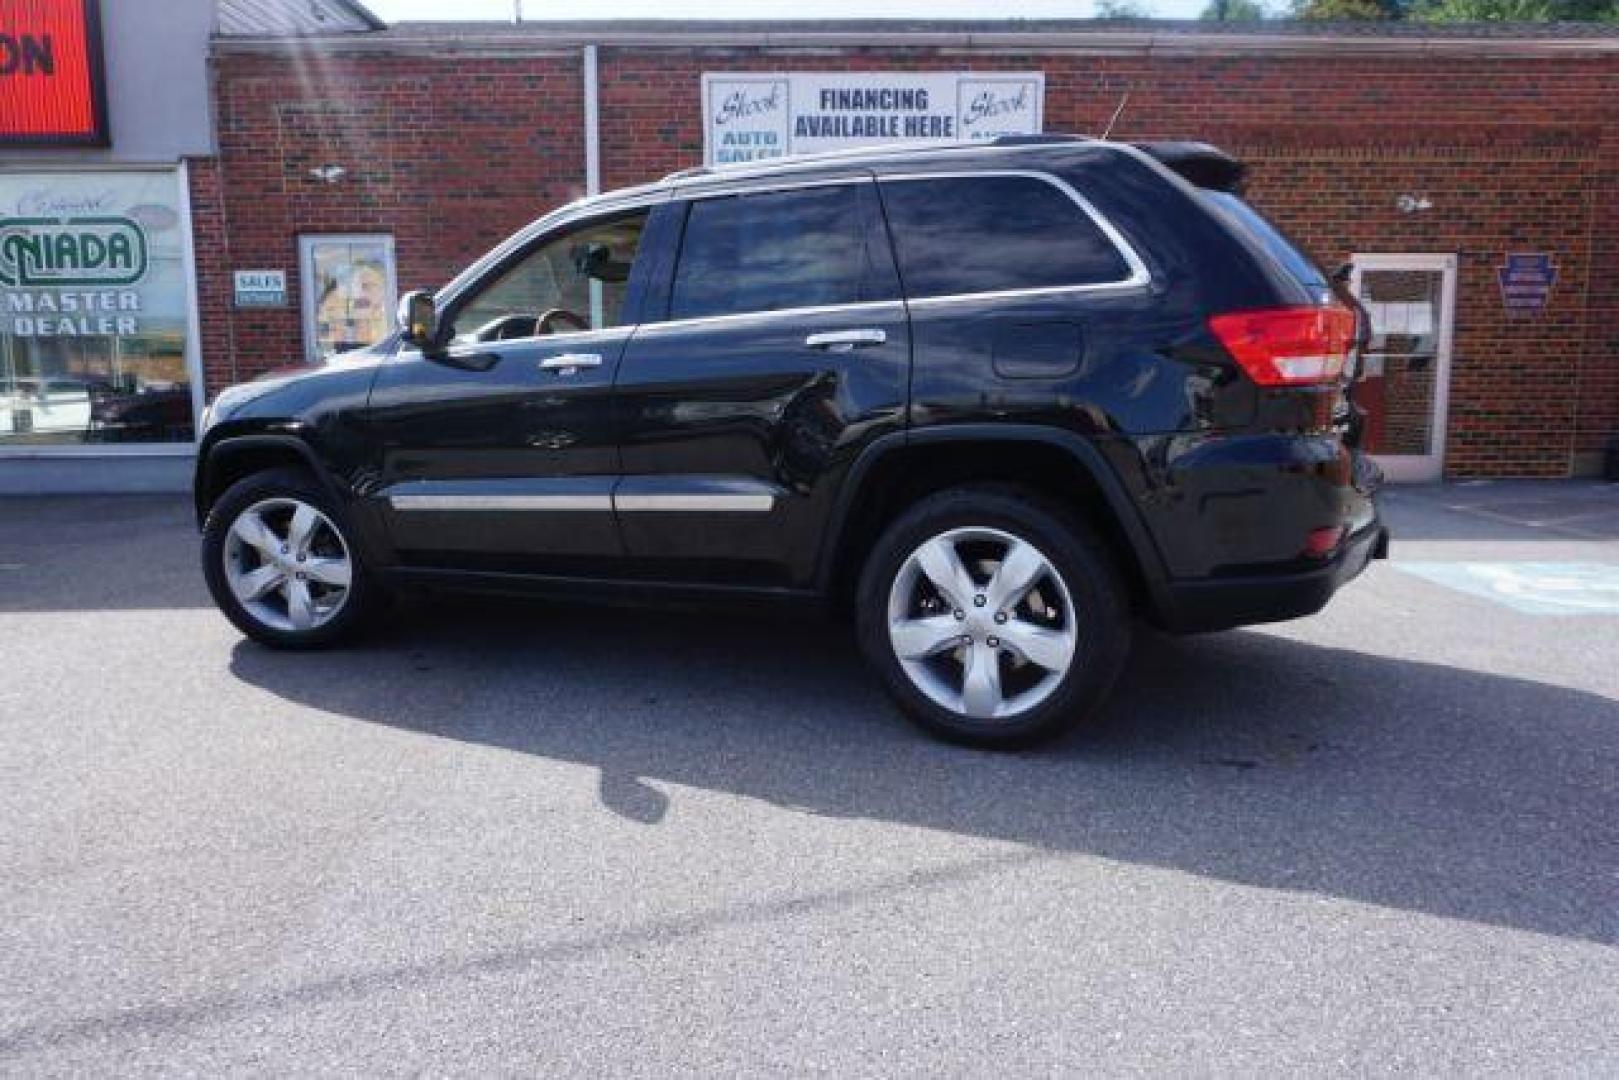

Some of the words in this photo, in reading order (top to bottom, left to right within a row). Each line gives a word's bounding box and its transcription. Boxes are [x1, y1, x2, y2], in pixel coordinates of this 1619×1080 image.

[819, 88, 929, 110] FINANCING
[795, 115, 900, 138] AVAILABLE
[905, 115, 953, 138] HERE
[722, 131, 778, 145] AUTO
[239, 275, 282, 289] SALES
[6, 292, 140, 312] MASTER
[14, 317, 137, 337] DEALER
